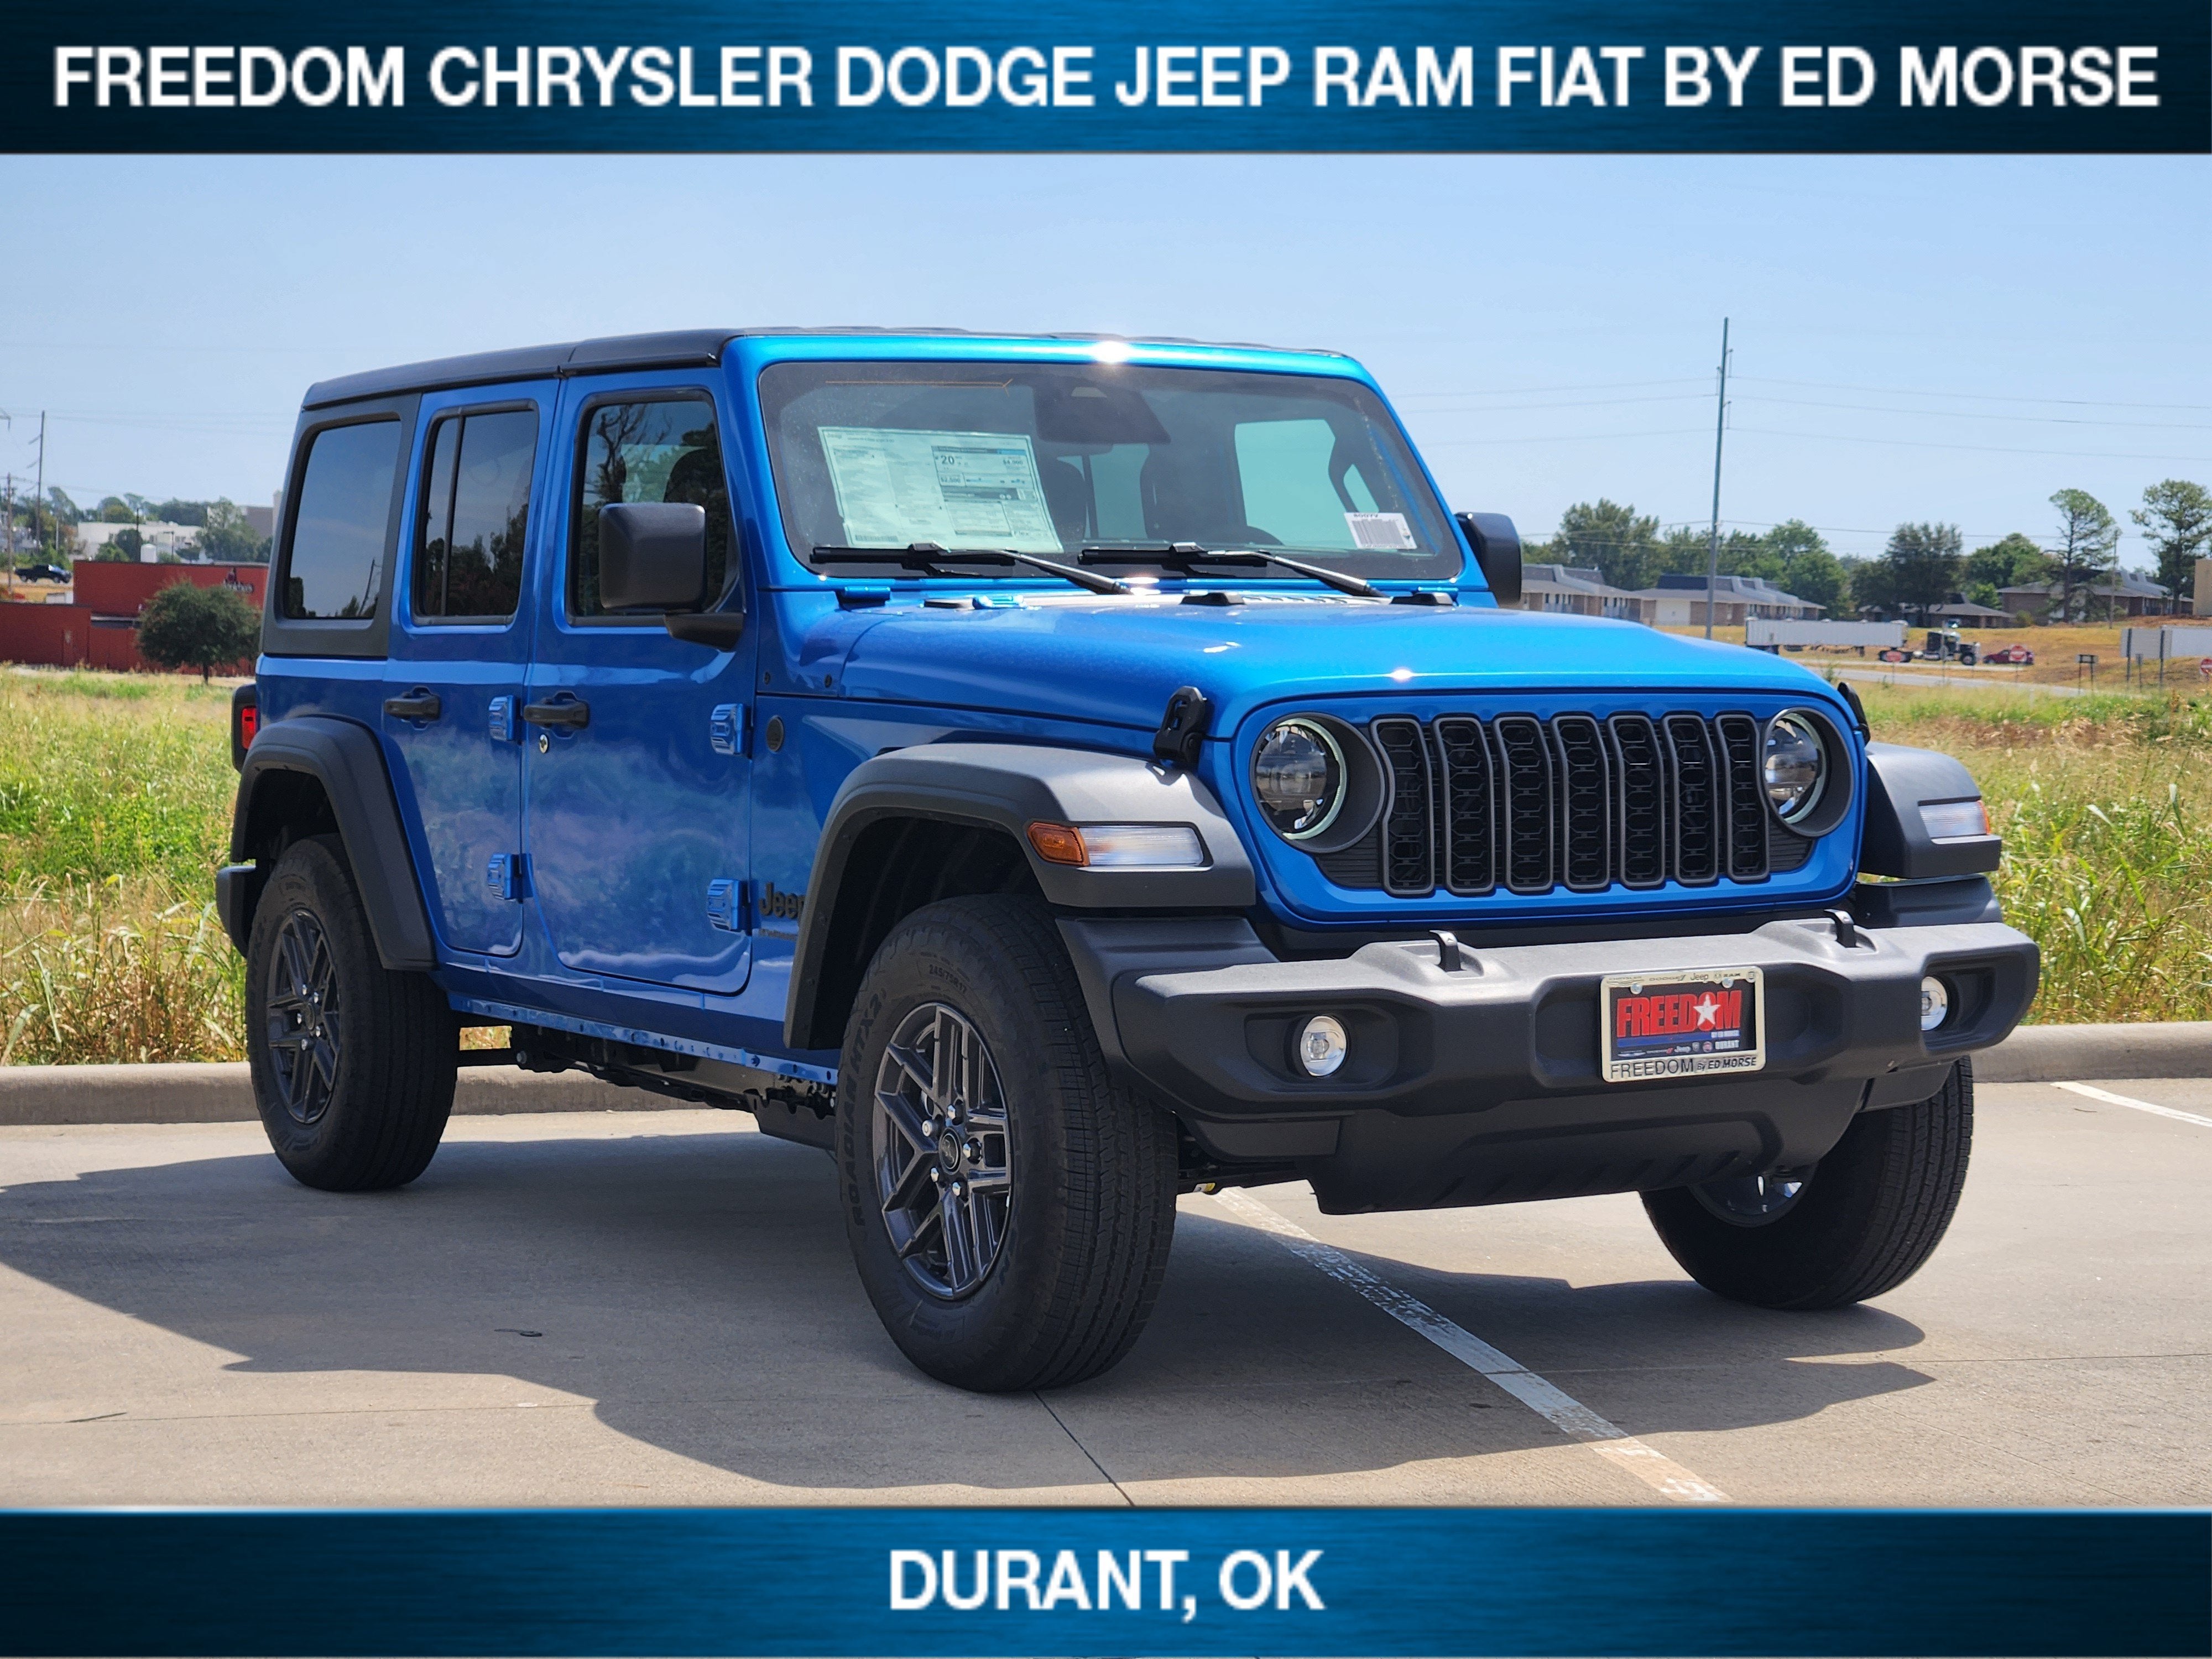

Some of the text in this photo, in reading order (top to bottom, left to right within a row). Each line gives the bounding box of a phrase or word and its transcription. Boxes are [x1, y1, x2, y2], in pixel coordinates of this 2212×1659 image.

[941, 455, 955, 466] 20
[1689, 972, 1709, 982] Jeep
[1616, 990, 1742, 1037] FREEDOM
[1610, 1057, 1694, 1079] FREEDOM
[1708, 1059, 1720, 1069] ED
[1722, 1056, 1757, 1068] MORSE
